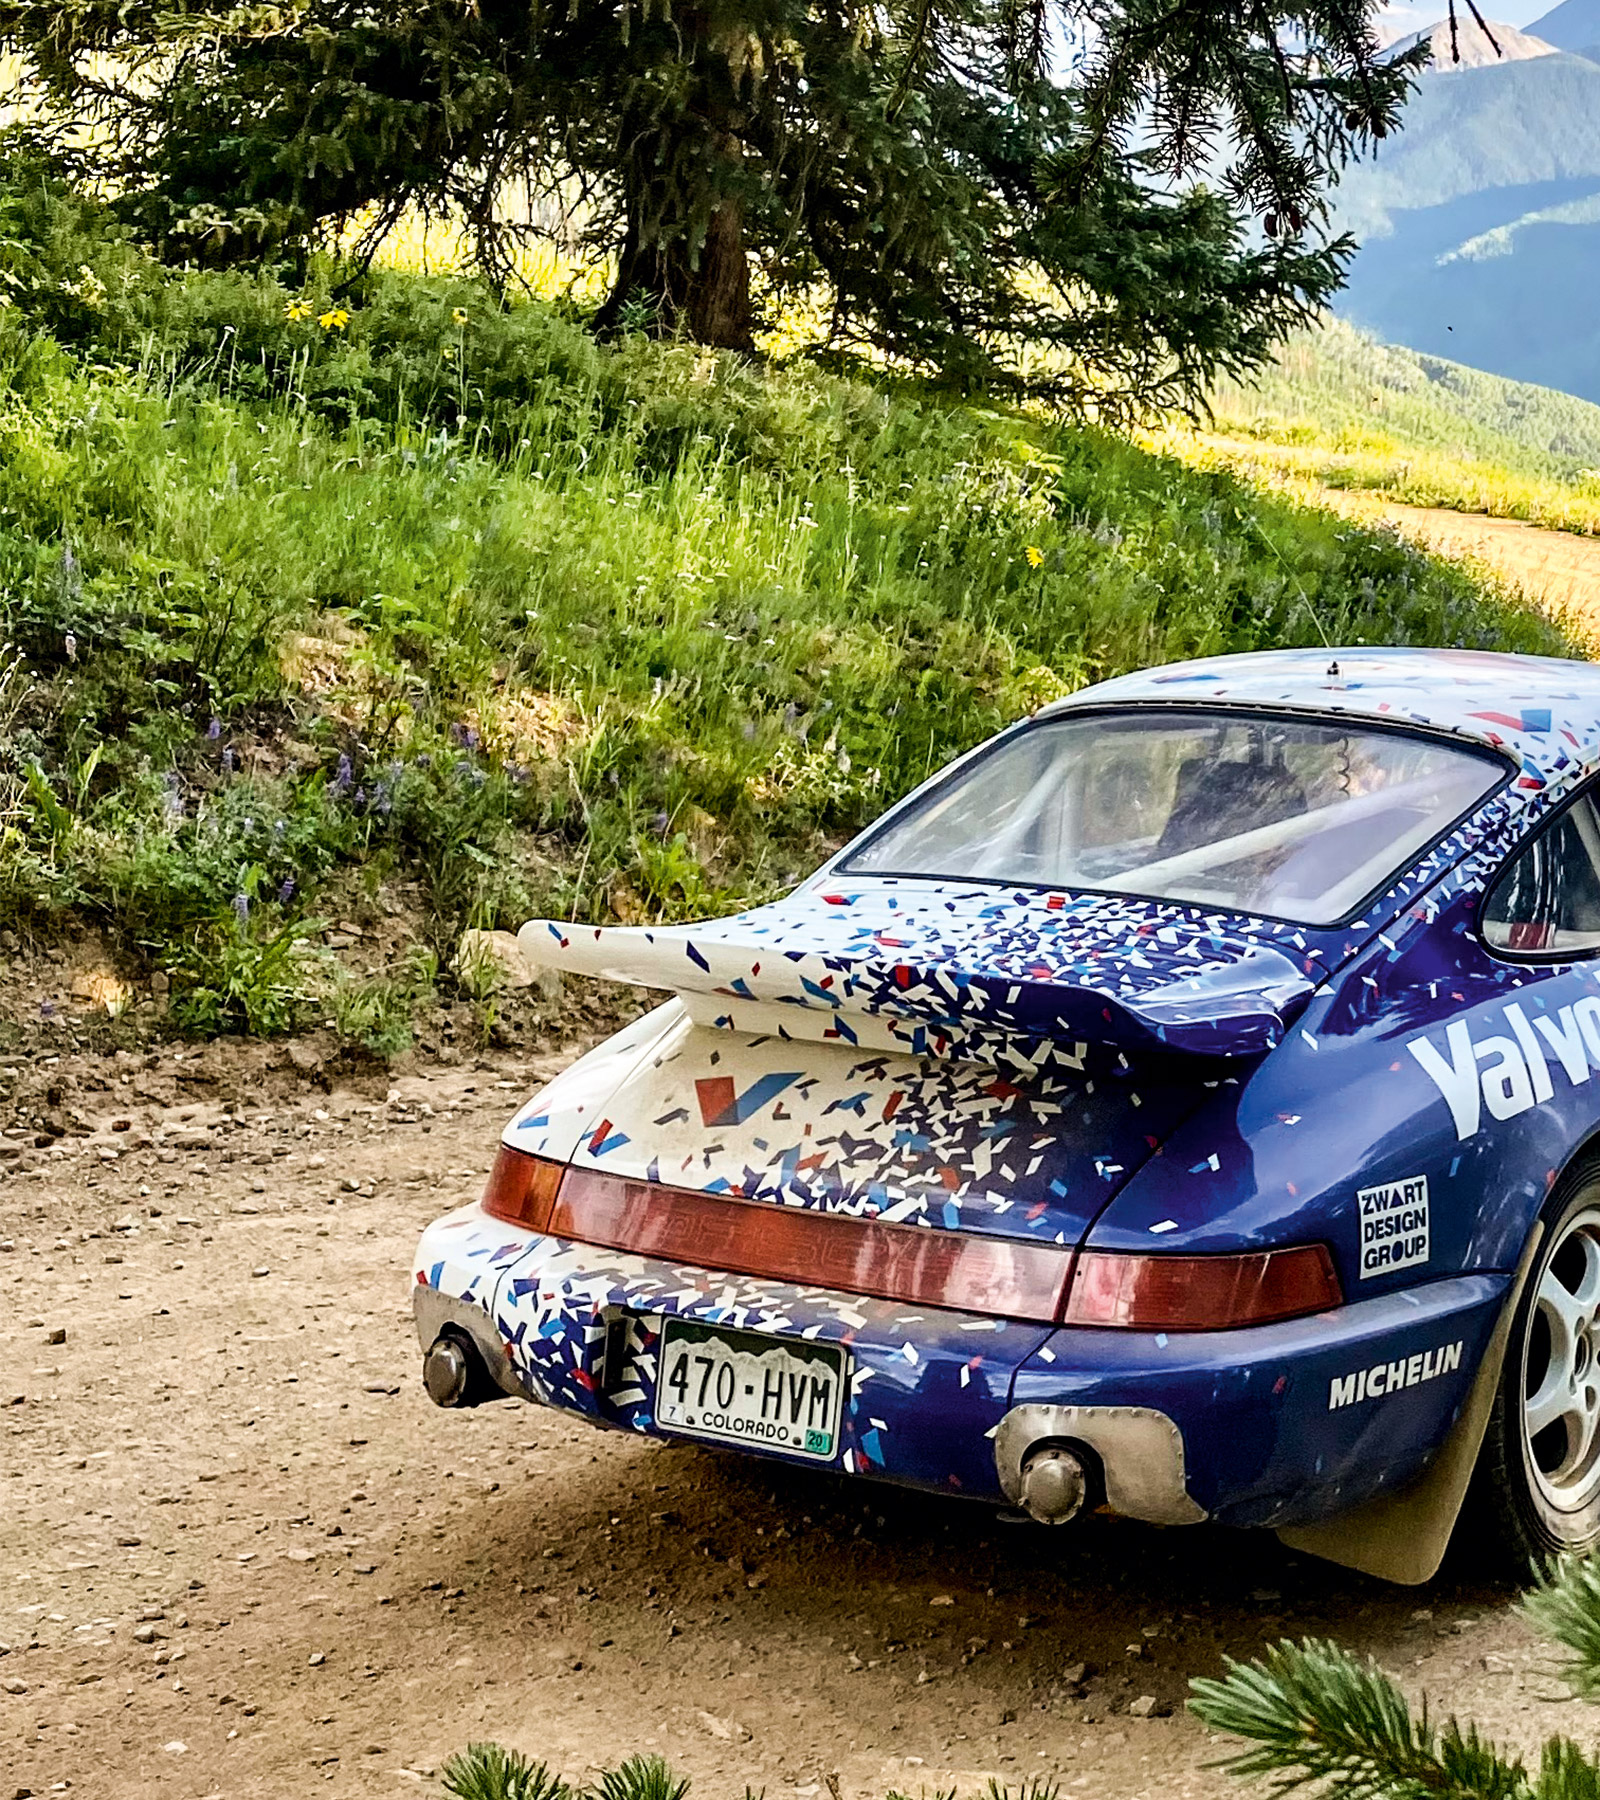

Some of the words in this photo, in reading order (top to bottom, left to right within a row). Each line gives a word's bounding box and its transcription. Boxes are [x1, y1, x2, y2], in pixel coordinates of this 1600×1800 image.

[1362, 1181, 1425, 1215] ZWART
[1364, 1207, 1427, 1243] DESIGN
[1364, 1235, 1427, 1269] GROUP
[1329, 1341, 1464, 1410] MICHELIN
[669, 1406, 677, 1418] 7
[702, 1412, 789, 1441] COLORADO
[808, 1433, 823, 1448] 20
